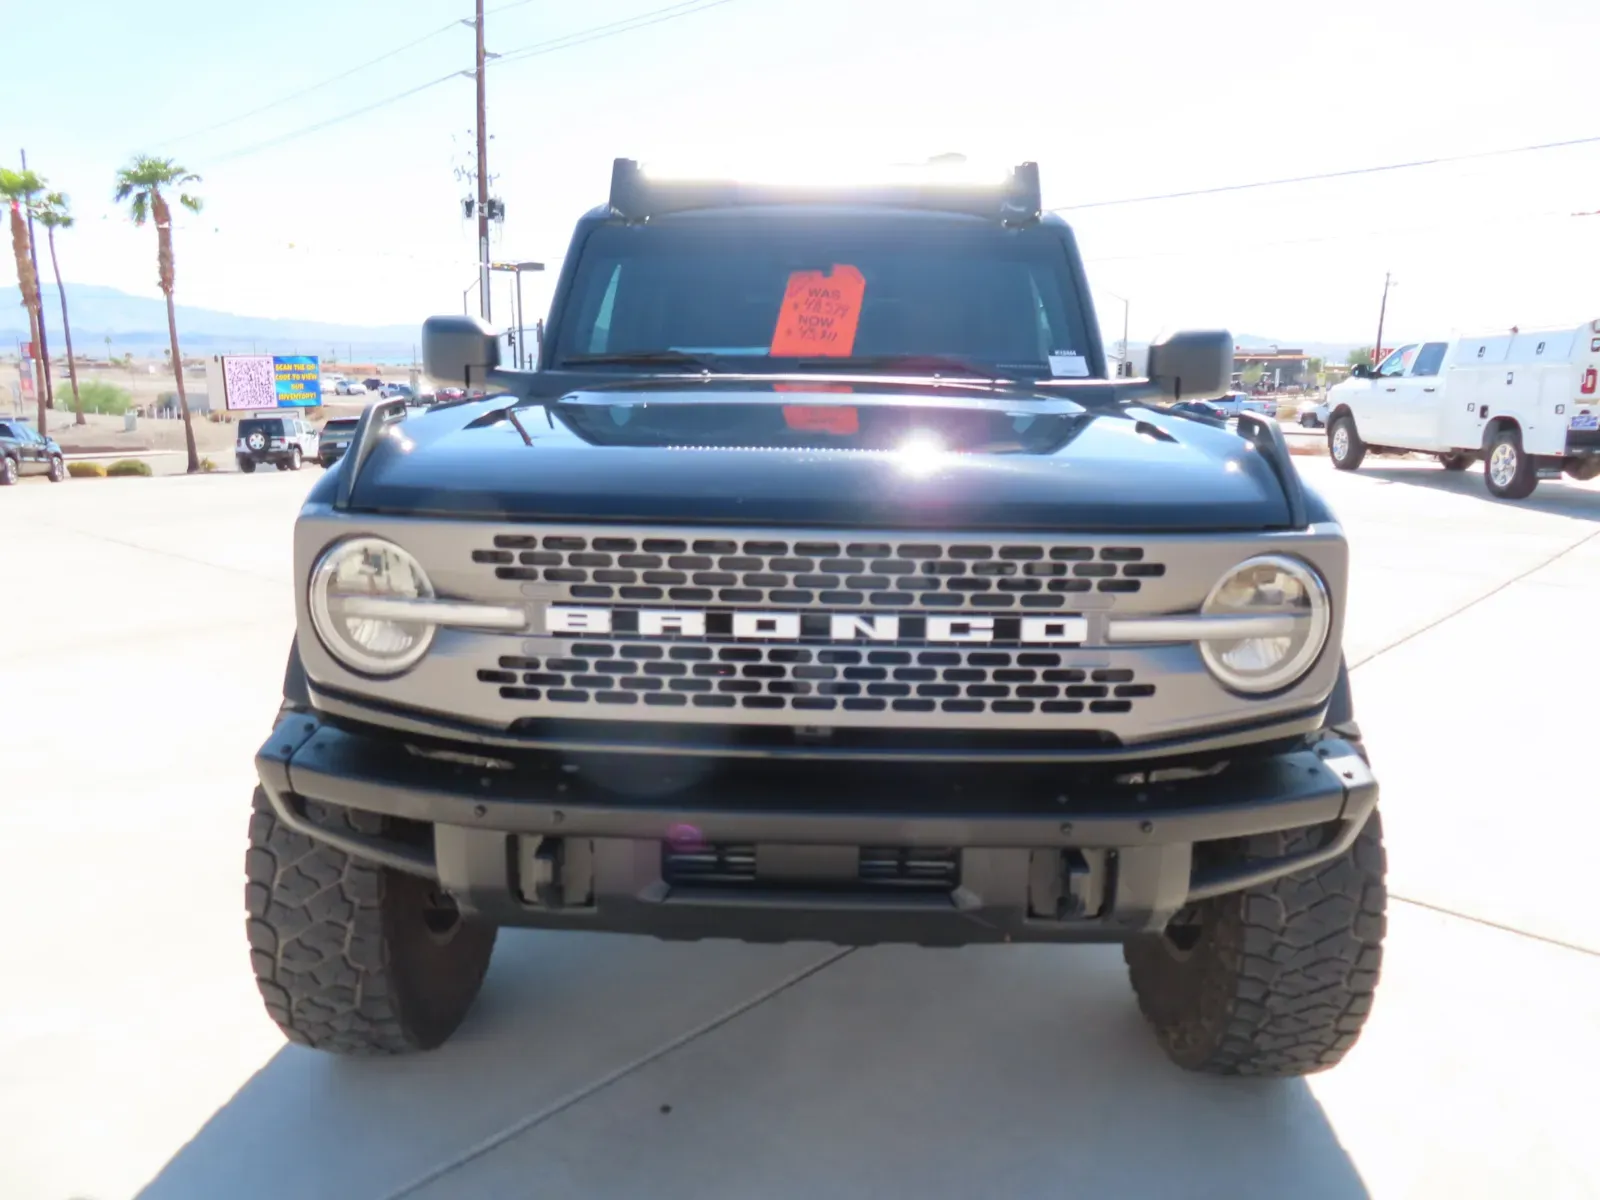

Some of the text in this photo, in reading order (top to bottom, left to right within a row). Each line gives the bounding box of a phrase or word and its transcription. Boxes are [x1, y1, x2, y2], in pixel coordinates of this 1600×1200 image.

[808, 287, 841, 300] WAS
[798, 314, 834, 328] NOW
[275, 363, 292, 371] SCAN
[293, 363, 305, 371] THE
[275, 373, 291, 381] CODE
[292, 373, 301, 381] TO
[279, 392, 316, 401] INVENTORY!
[546, 605, 1087, 643] BRONCO
